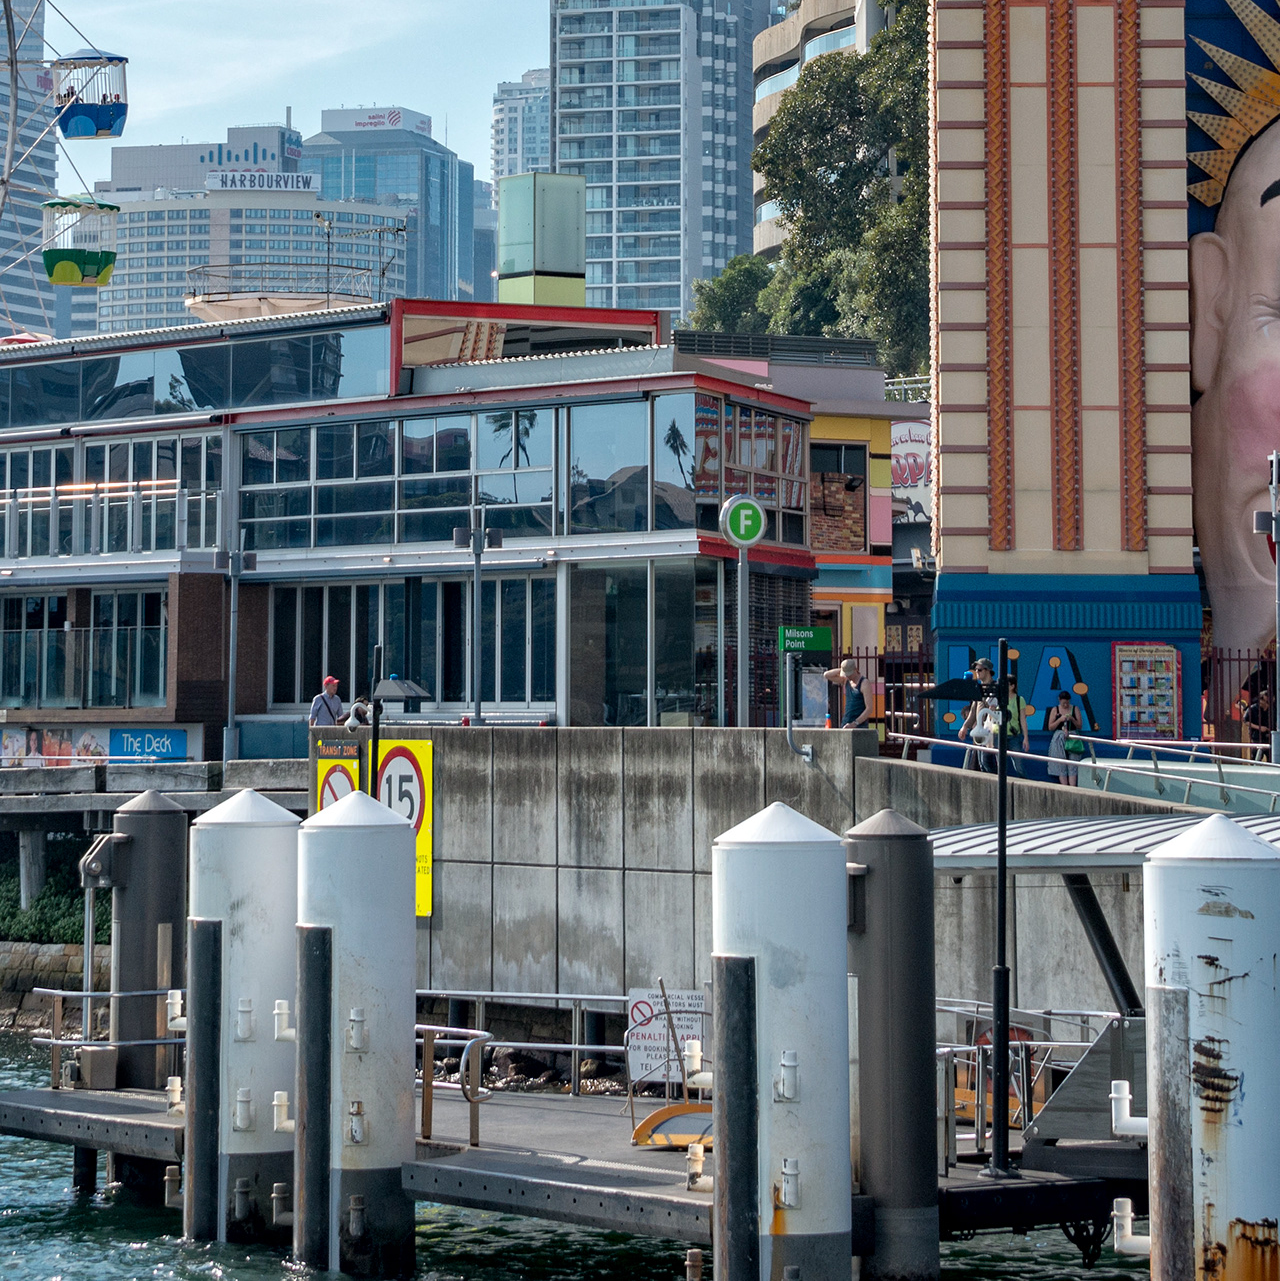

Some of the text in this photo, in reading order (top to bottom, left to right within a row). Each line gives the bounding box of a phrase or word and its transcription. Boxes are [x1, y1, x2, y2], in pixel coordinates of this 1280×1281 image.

[220, 173, 313, 190] HARBOURVIEW
[740, 509, 753, 535] F
[785, 629, 814, 638] Milsons
[785, 639, 805, 648] Point
[122, 733, 172, 753] The Deck
[319, 744, 358, 756] TRANSIT ZONE
[385, 773, 415, 821] 15
[630, 1031, 676, 1041] PENALTIS
